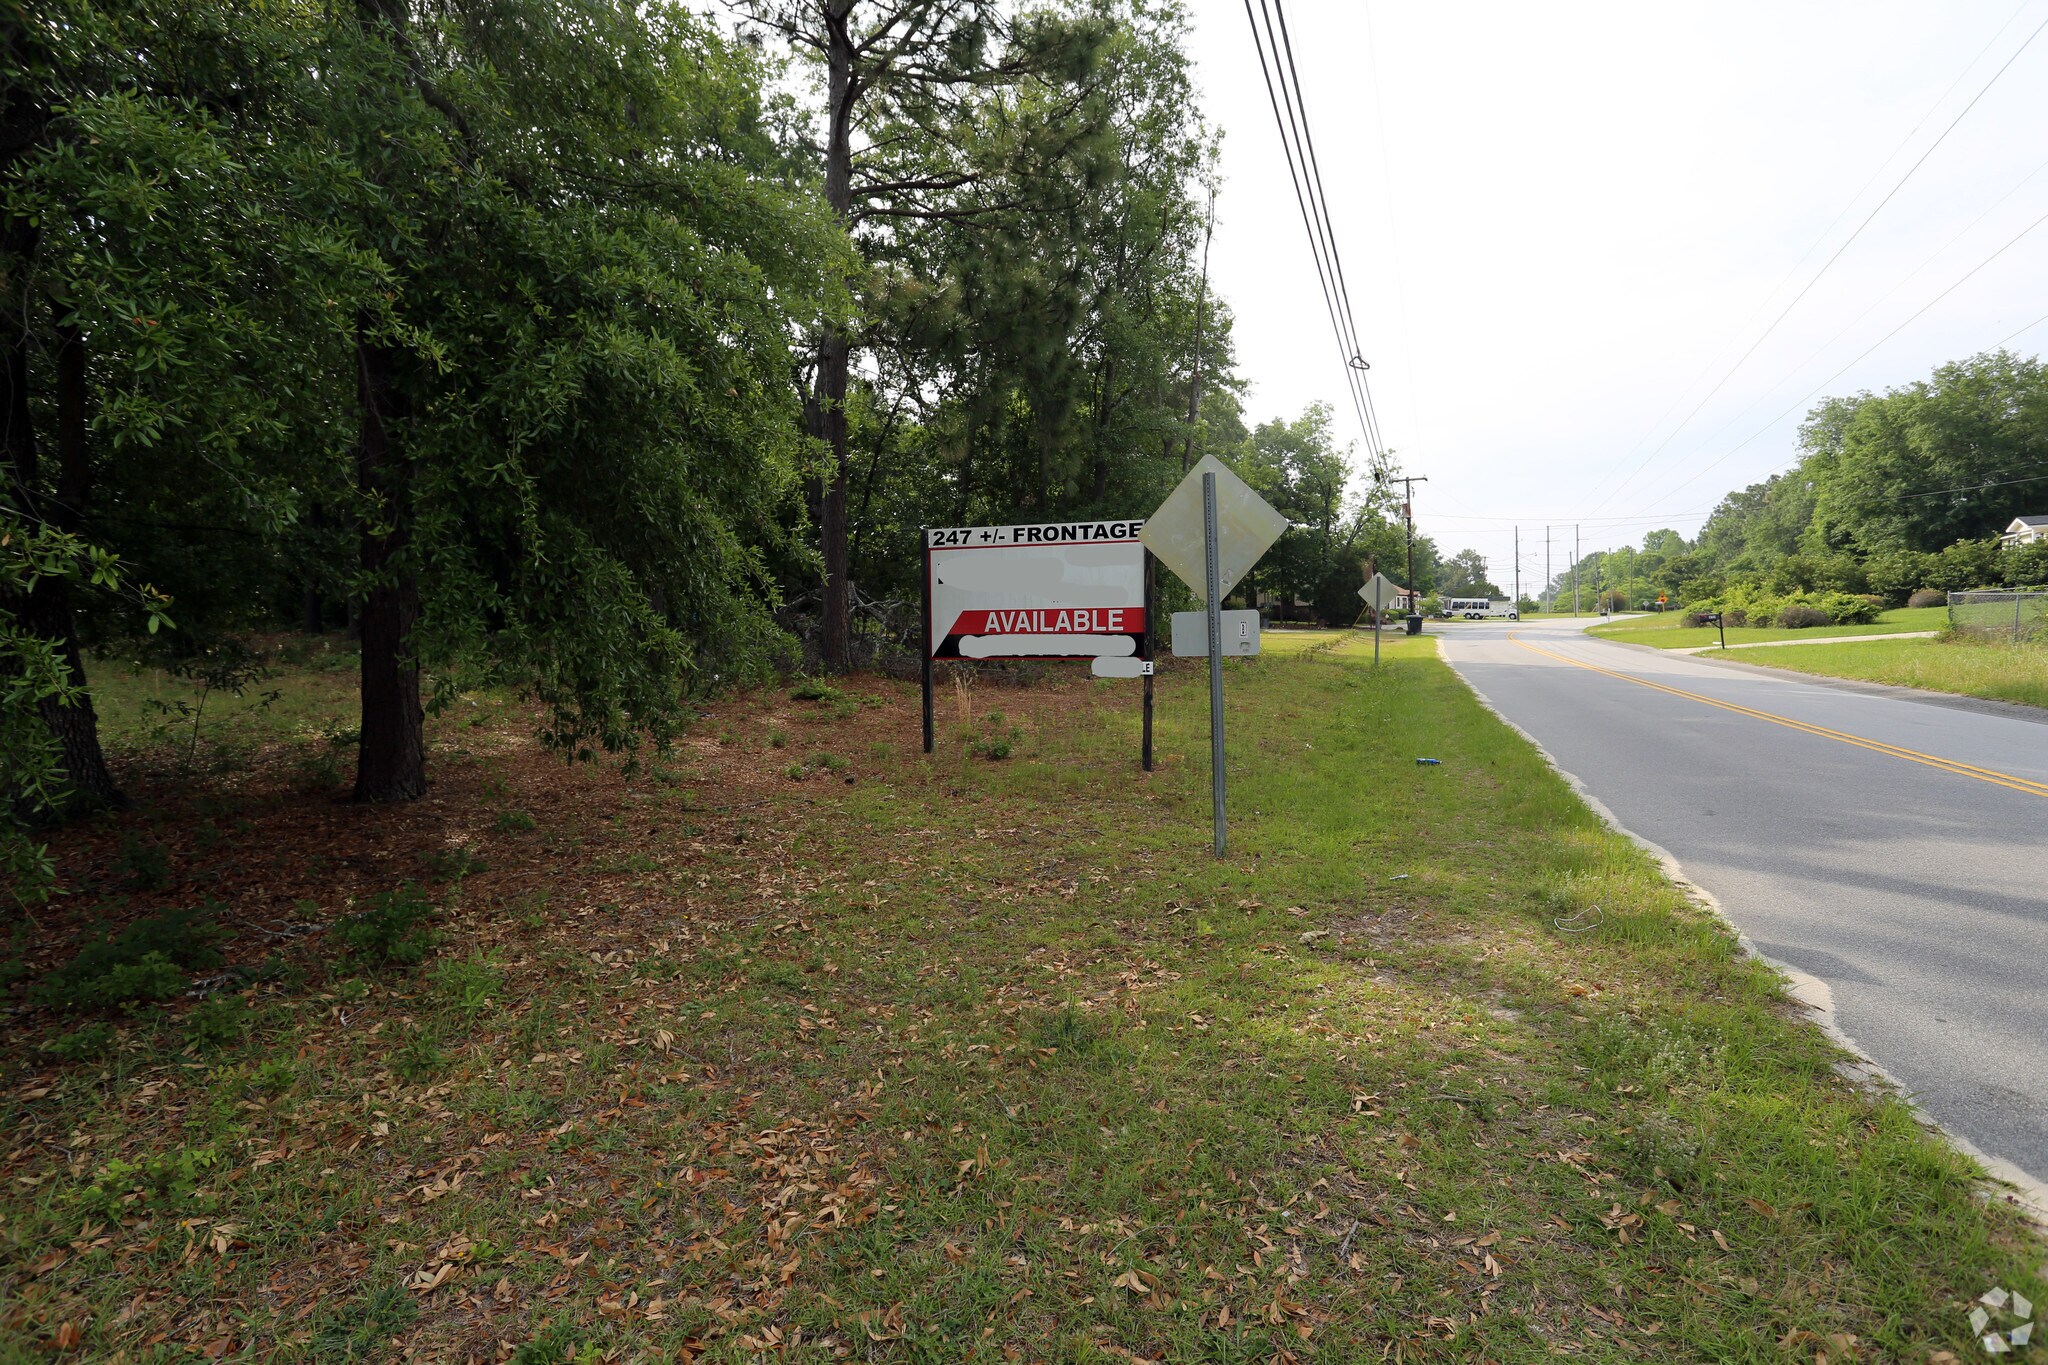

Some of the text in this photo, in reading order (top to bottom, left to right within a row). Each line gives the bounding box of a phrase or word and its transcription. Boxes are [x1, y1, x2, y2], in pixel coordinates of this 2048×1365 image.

[933, 522, 1143, 546] 247 +/- FRONTAGE
[984, 609, 1124, 633] AVAILABLE
